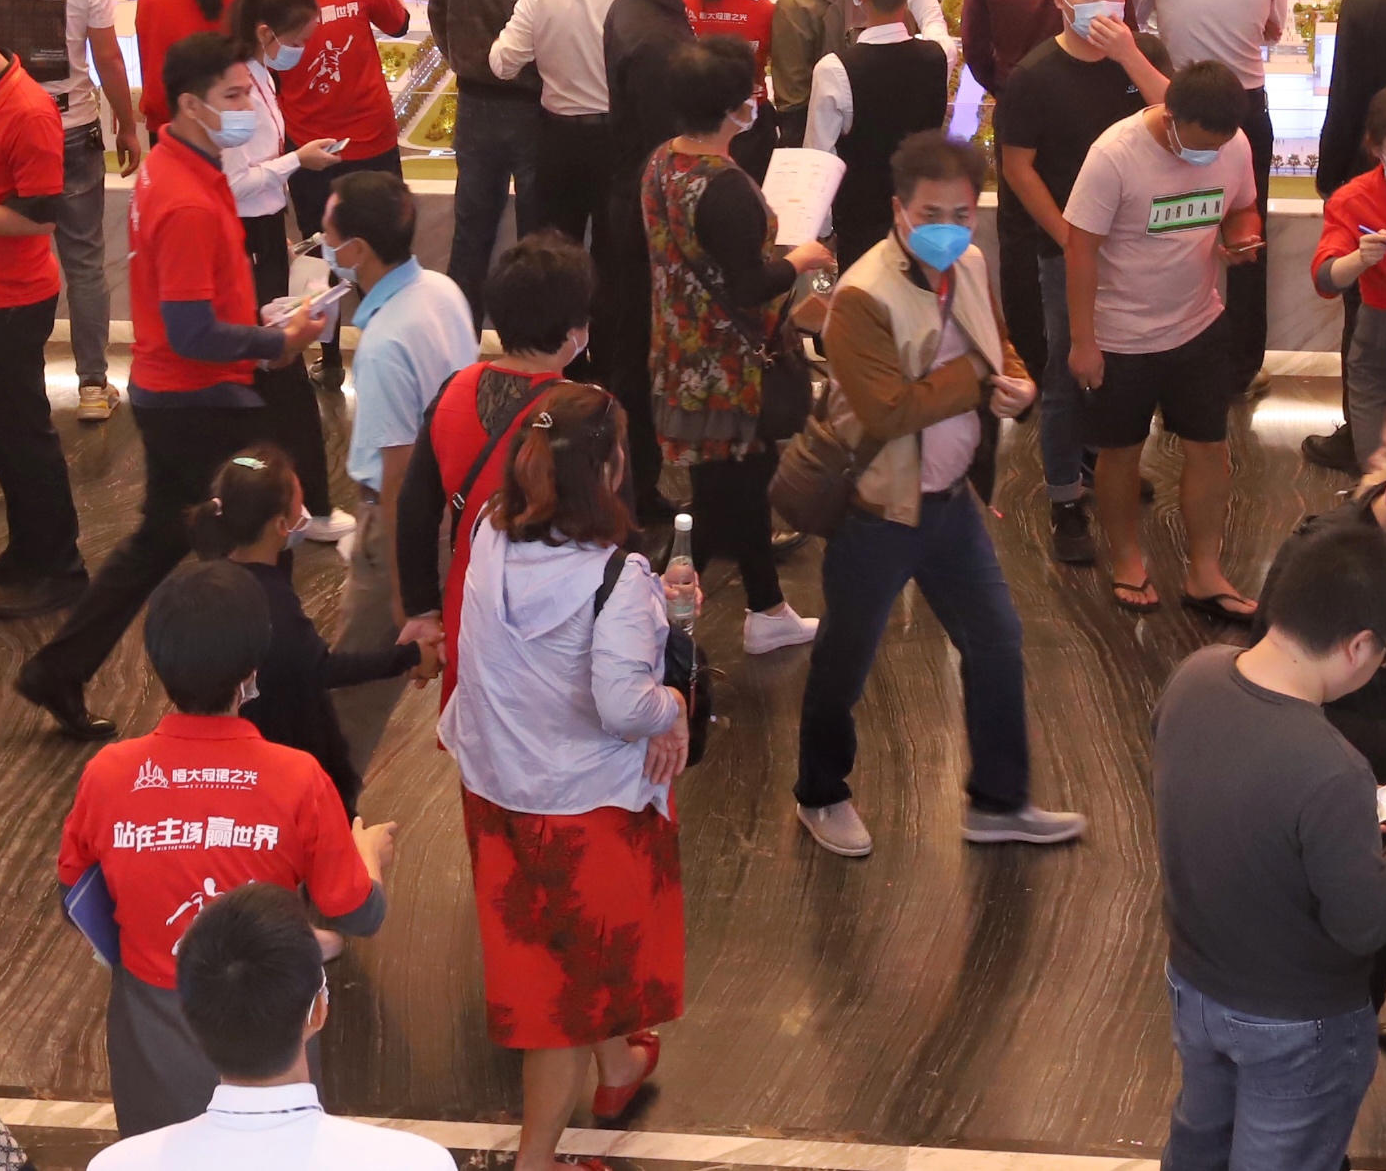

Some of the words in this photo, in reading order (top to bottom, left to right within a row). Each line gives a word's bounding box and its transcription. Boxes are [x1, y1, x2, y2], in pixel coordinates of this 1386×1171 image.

[316, 1, 359, 25] 赢世界
[1153, 200, 1221, 223] JORDAN
[172, 768, 258, 785] 恒大冠珺之光
[113, 817, 279, 853] 站在主场赢世界
